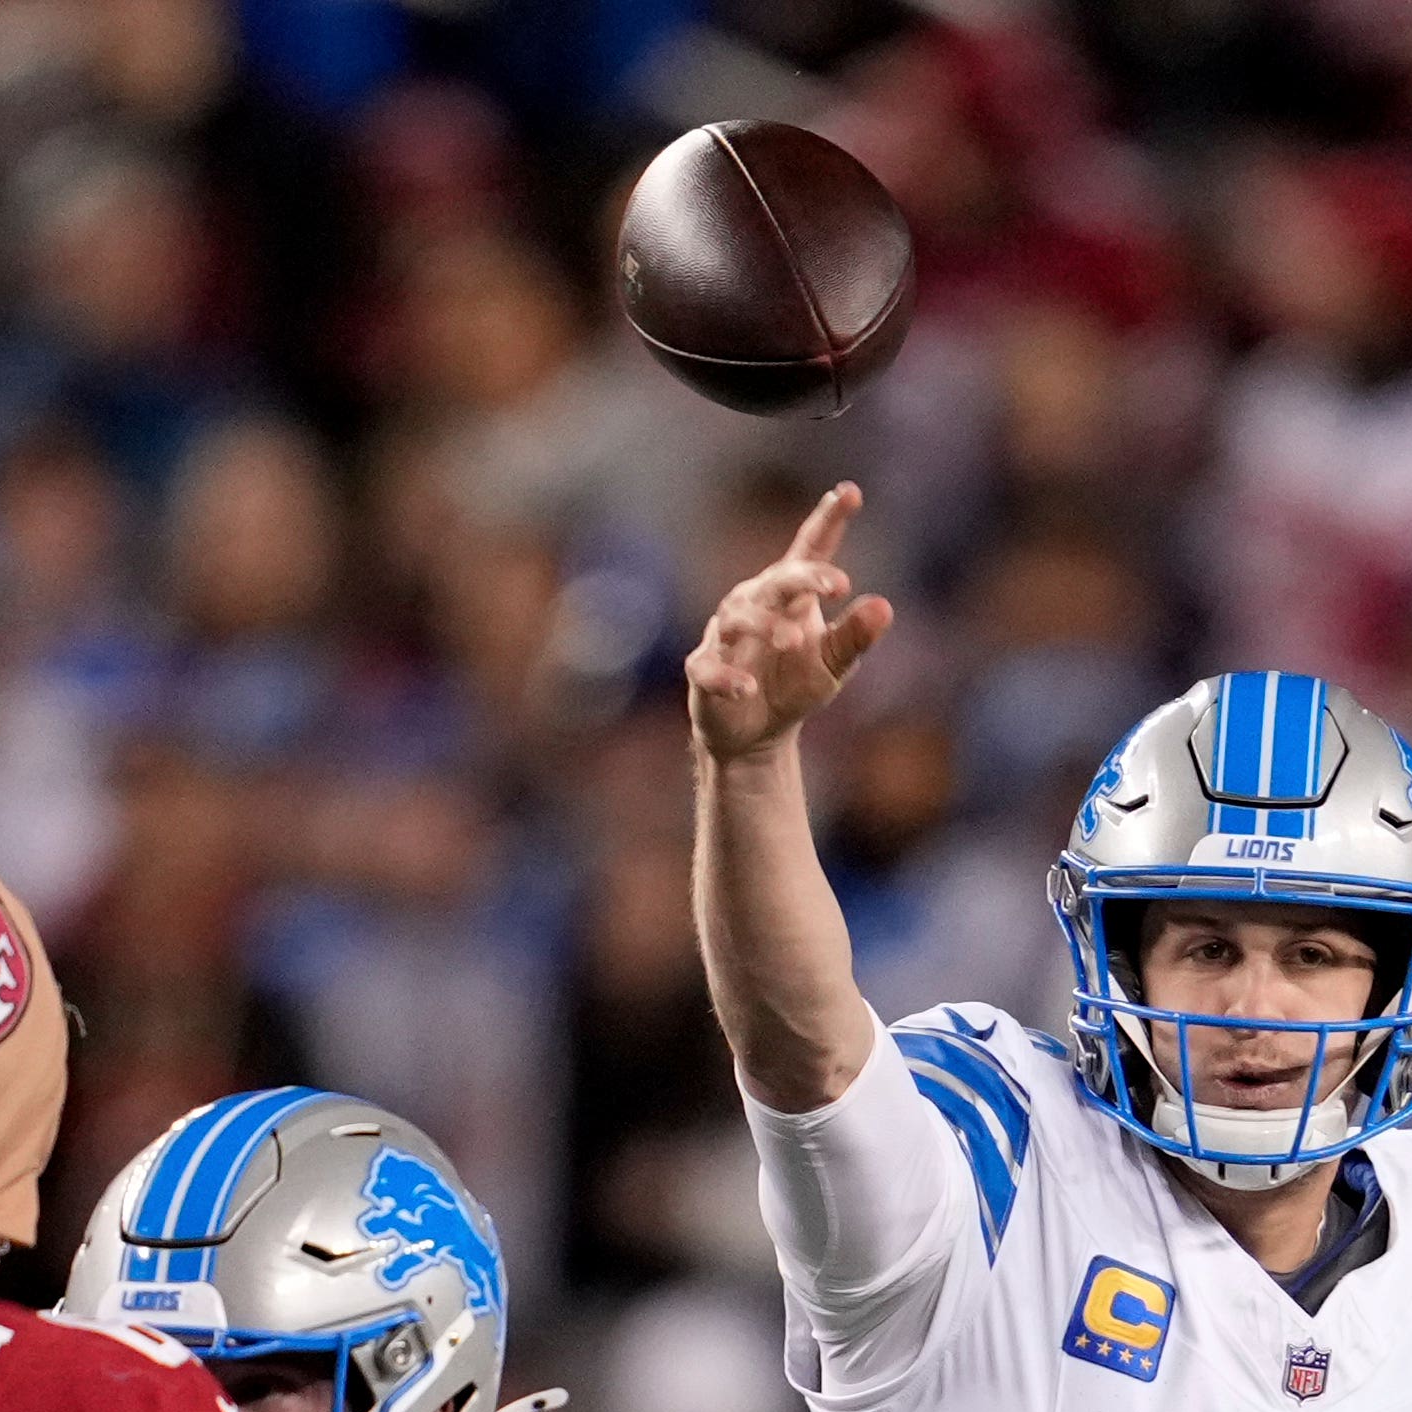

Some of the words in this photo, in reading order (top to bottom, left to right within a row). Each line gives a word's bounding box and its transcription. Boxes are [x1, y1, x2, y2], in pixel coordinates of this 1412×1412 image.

[1226, 838, 1296, 863] LIONS
[122, 1290, 182, 1311] LIONS
[1083, 1267, 1168, 1350] C
[1290, 1368, 1322, 1394] NFL
